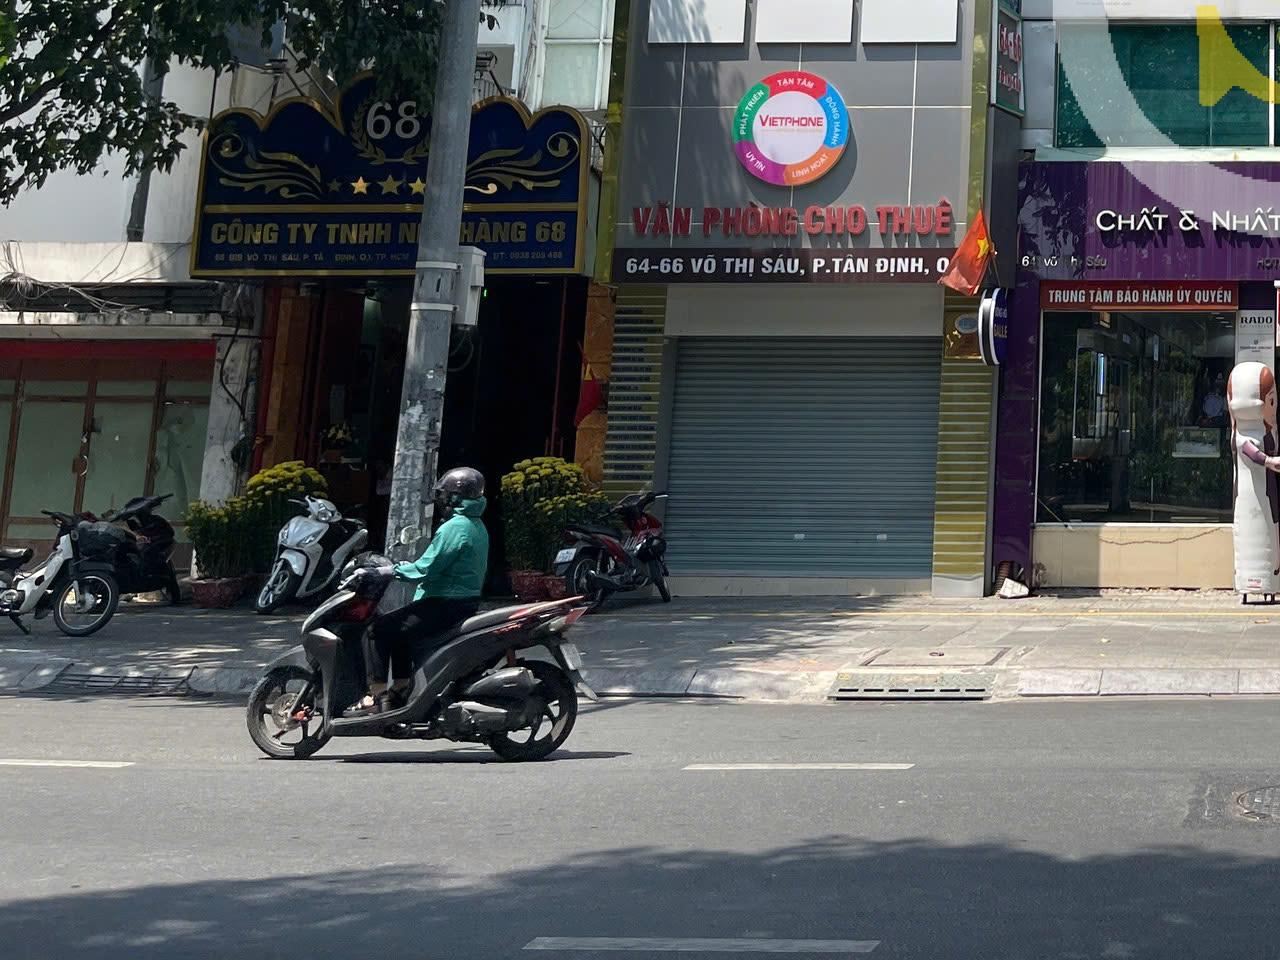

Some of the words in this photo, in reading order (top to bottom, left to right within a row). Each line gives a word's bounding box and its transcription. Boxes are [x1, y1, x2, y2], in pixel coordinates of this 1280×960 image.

[365, 99, 421, 140] 68
[760, 115, 823, 127] VIETPHONE
[632, 201, 693, 236] VĂN
[703, 201, 798, 236] PHÒNG
[804, 205, 867, 236] CHO
[876, 199, 953, 236] THUÊ
[1095, 207, 1168, 231] CHẤT
[1179, 210, 1199, 231] &
[211, 219, 280, 244] CÔNG
[288, 223, 319, 244] TY
[327, 223, 391, 244] TNHH
[535, 221, 566, 243] 68
[626, 257, 683, 274] 64-66
[690, 254, 716, 274] VÕ
[723, 258, 754, 276] THỊ
[762, 253, 805, 277] SÁU,
[813, 253, 868, 274] P.TÂN
[875, 257, 930, 277] ĐỊNH,
[1049, 289, 1086, 303] TRUNG
[1142, 287, 1173, 303] HÀNH
[1240, 316, 1273, 324] RADO
